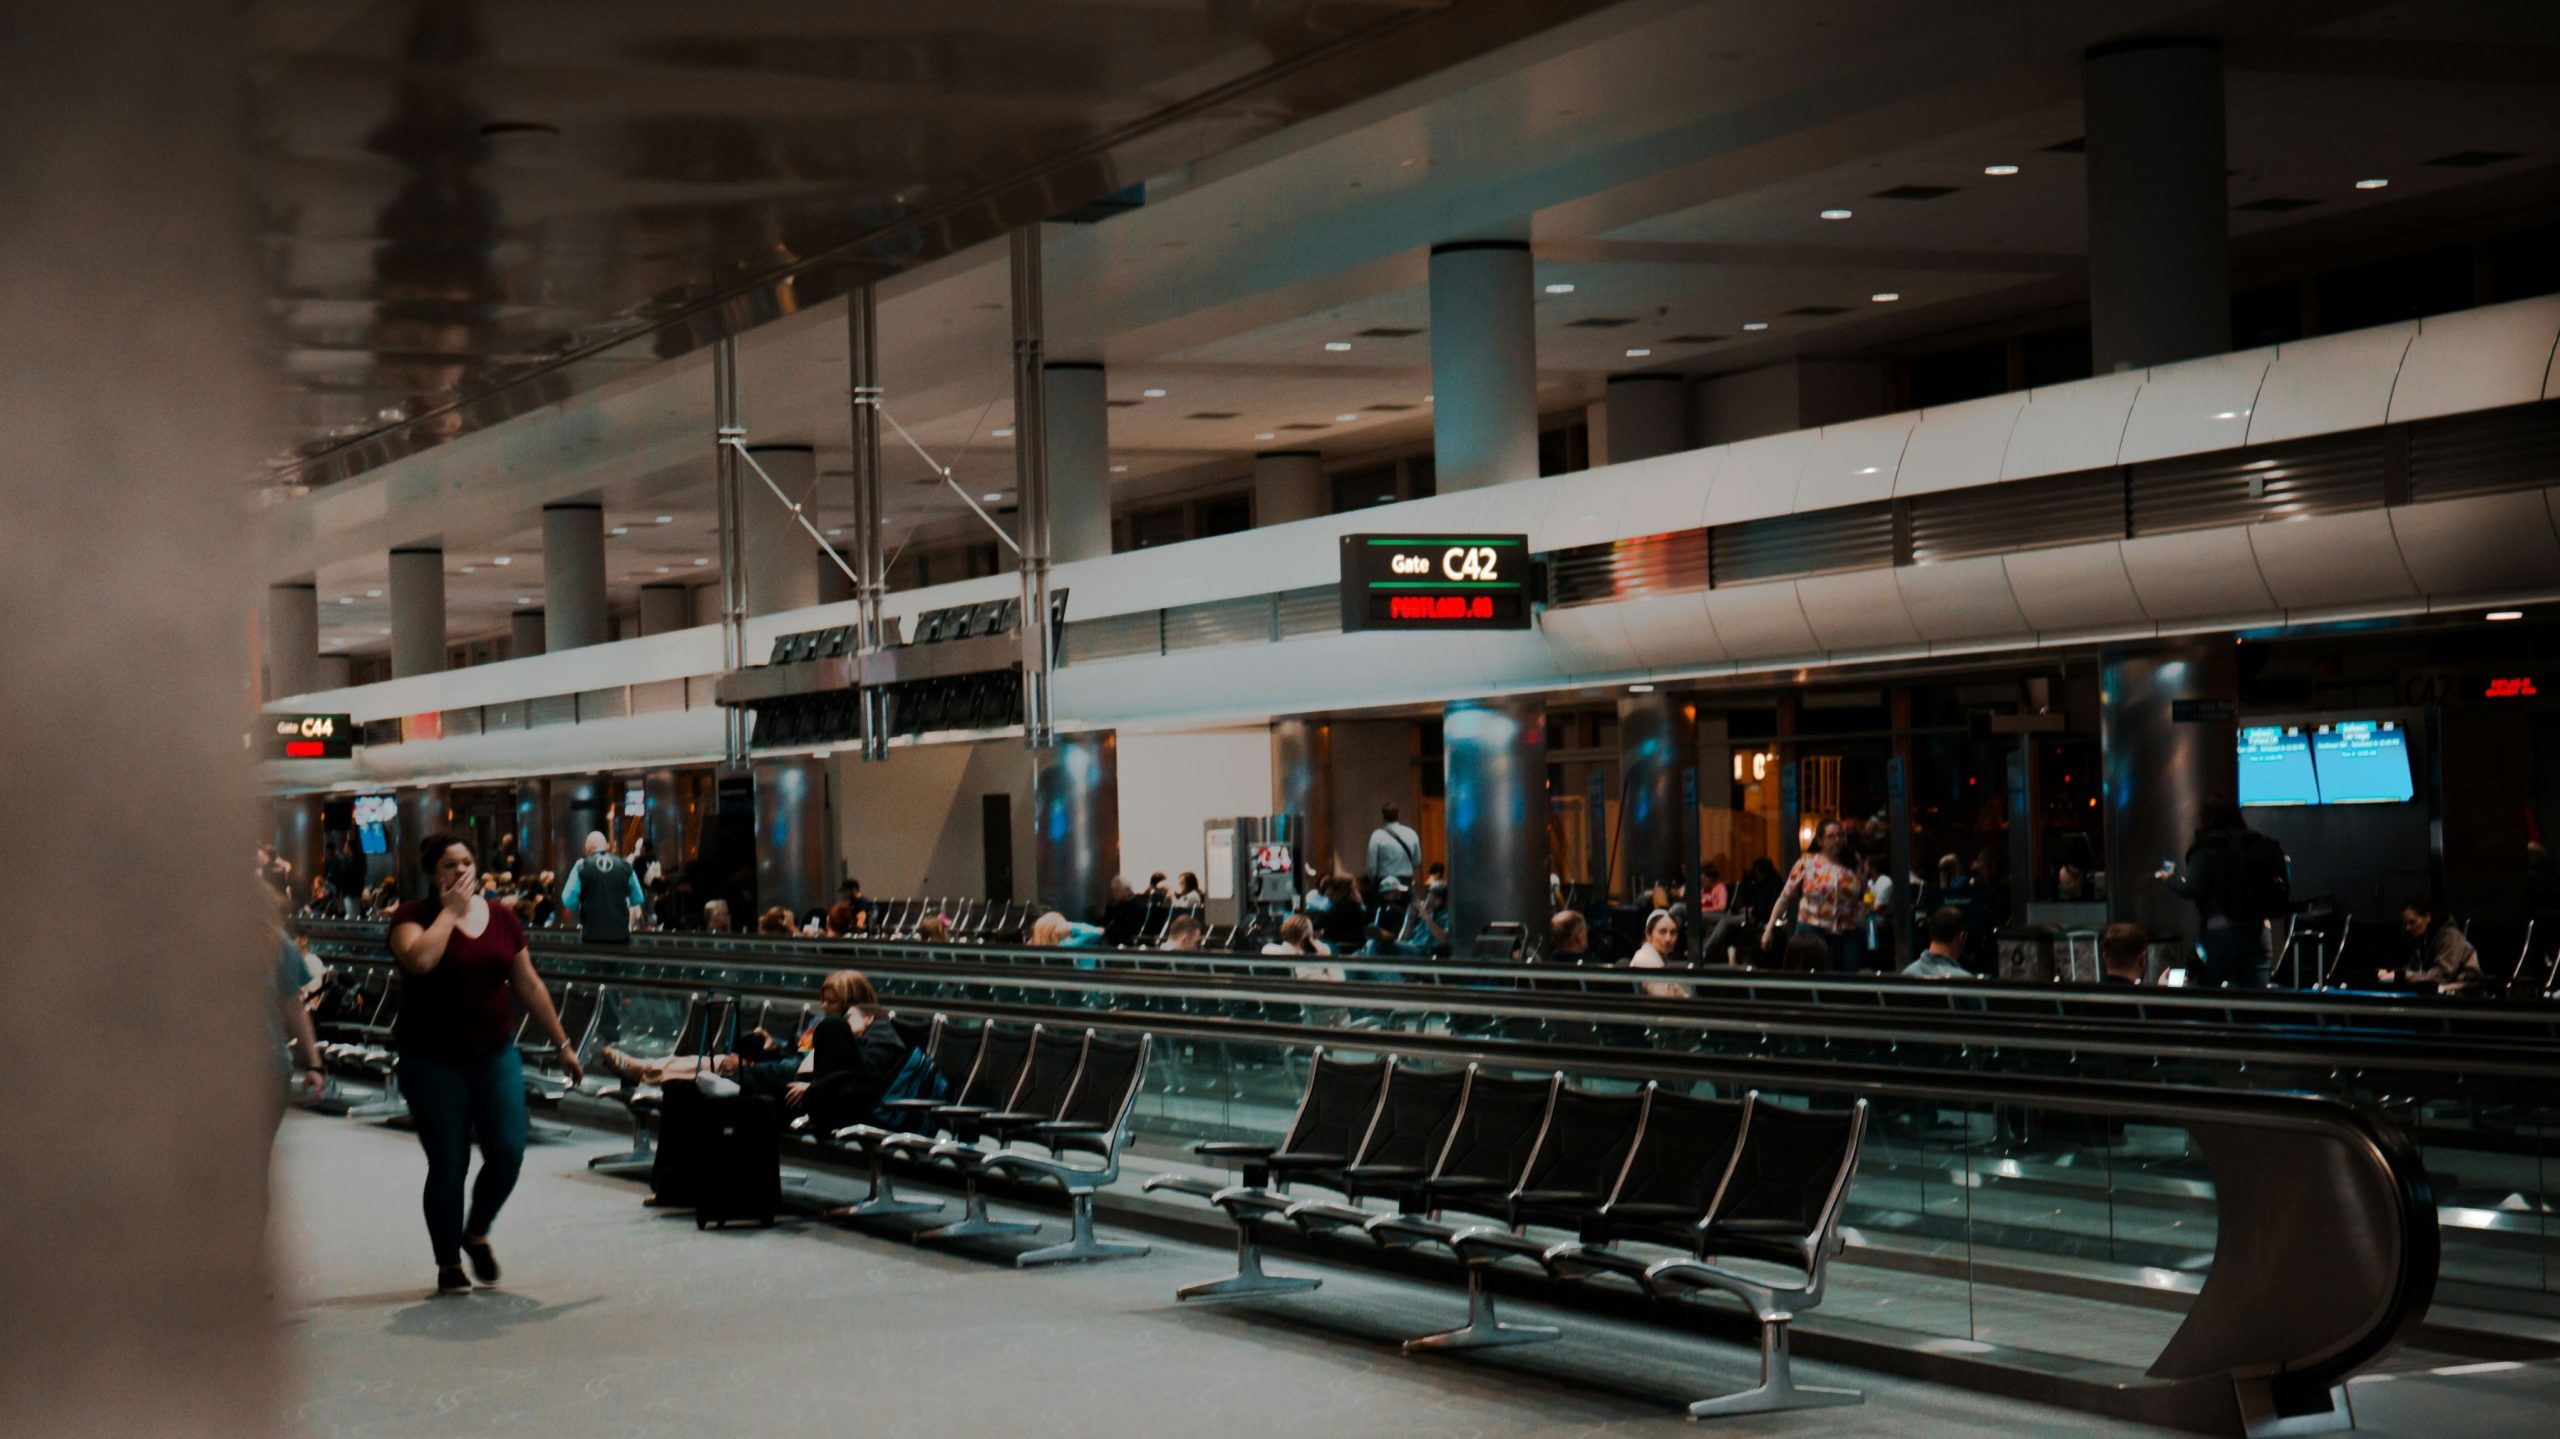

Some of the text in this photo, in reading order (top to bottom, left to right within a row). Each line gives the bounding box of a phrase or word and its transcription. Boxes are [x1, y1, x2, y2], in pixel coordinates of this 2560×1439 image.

[1391, 547, 1498, 581] Gate C42
[2406, 674, 2449, 706] C42
[301, 717, 334, 738] C44
